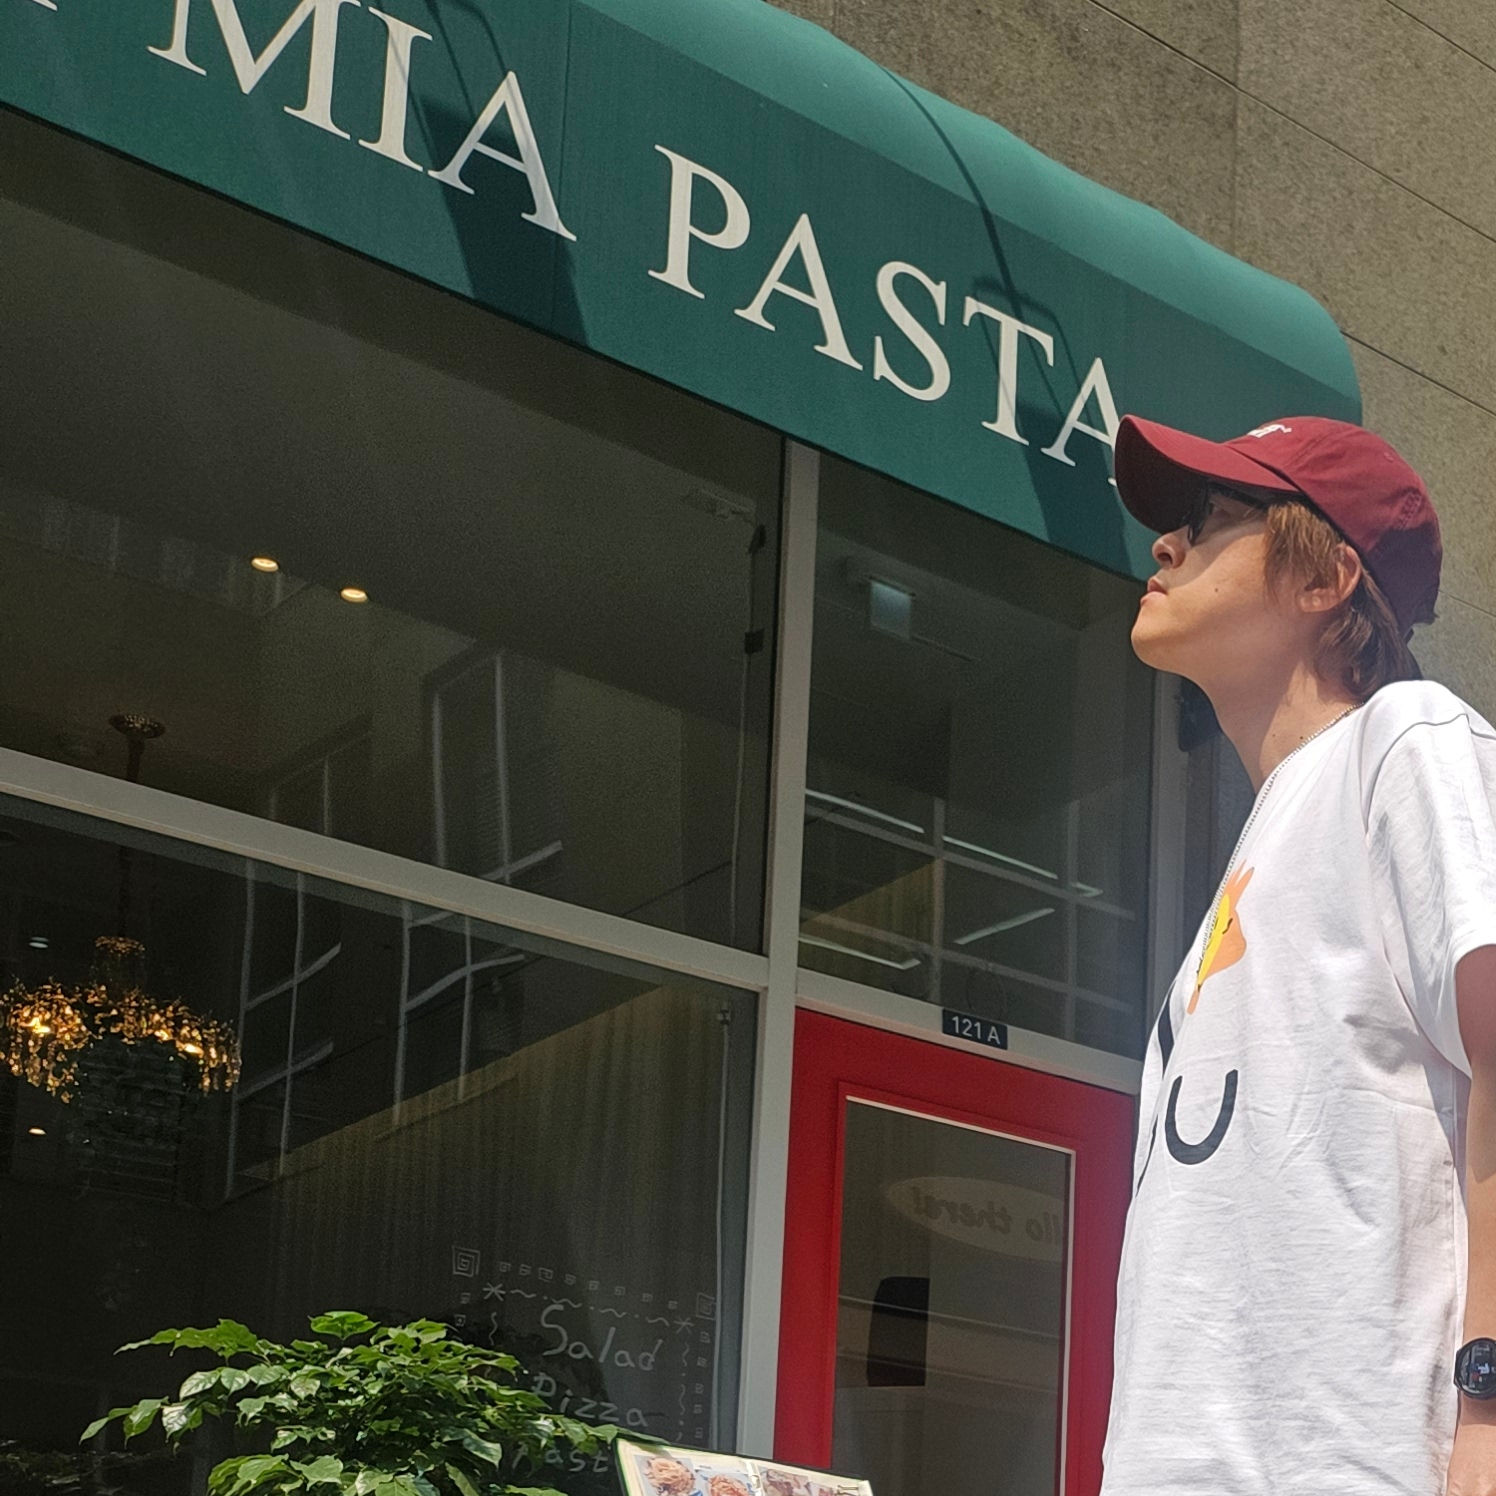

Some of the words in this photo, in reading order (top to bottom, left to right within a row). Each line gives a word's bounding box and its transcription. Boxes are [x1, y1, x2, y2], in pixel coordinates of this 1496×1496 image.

[147, 0, 577, 242] MIA
[648, 144, 1121, 487] PASTA
[951, 1015, 982, 1040] 121
[987, 1025, 1001, 1045] A
[540, 1304, 664, 1371] Salad
[531, 1372, 648, 1427] Pizza
